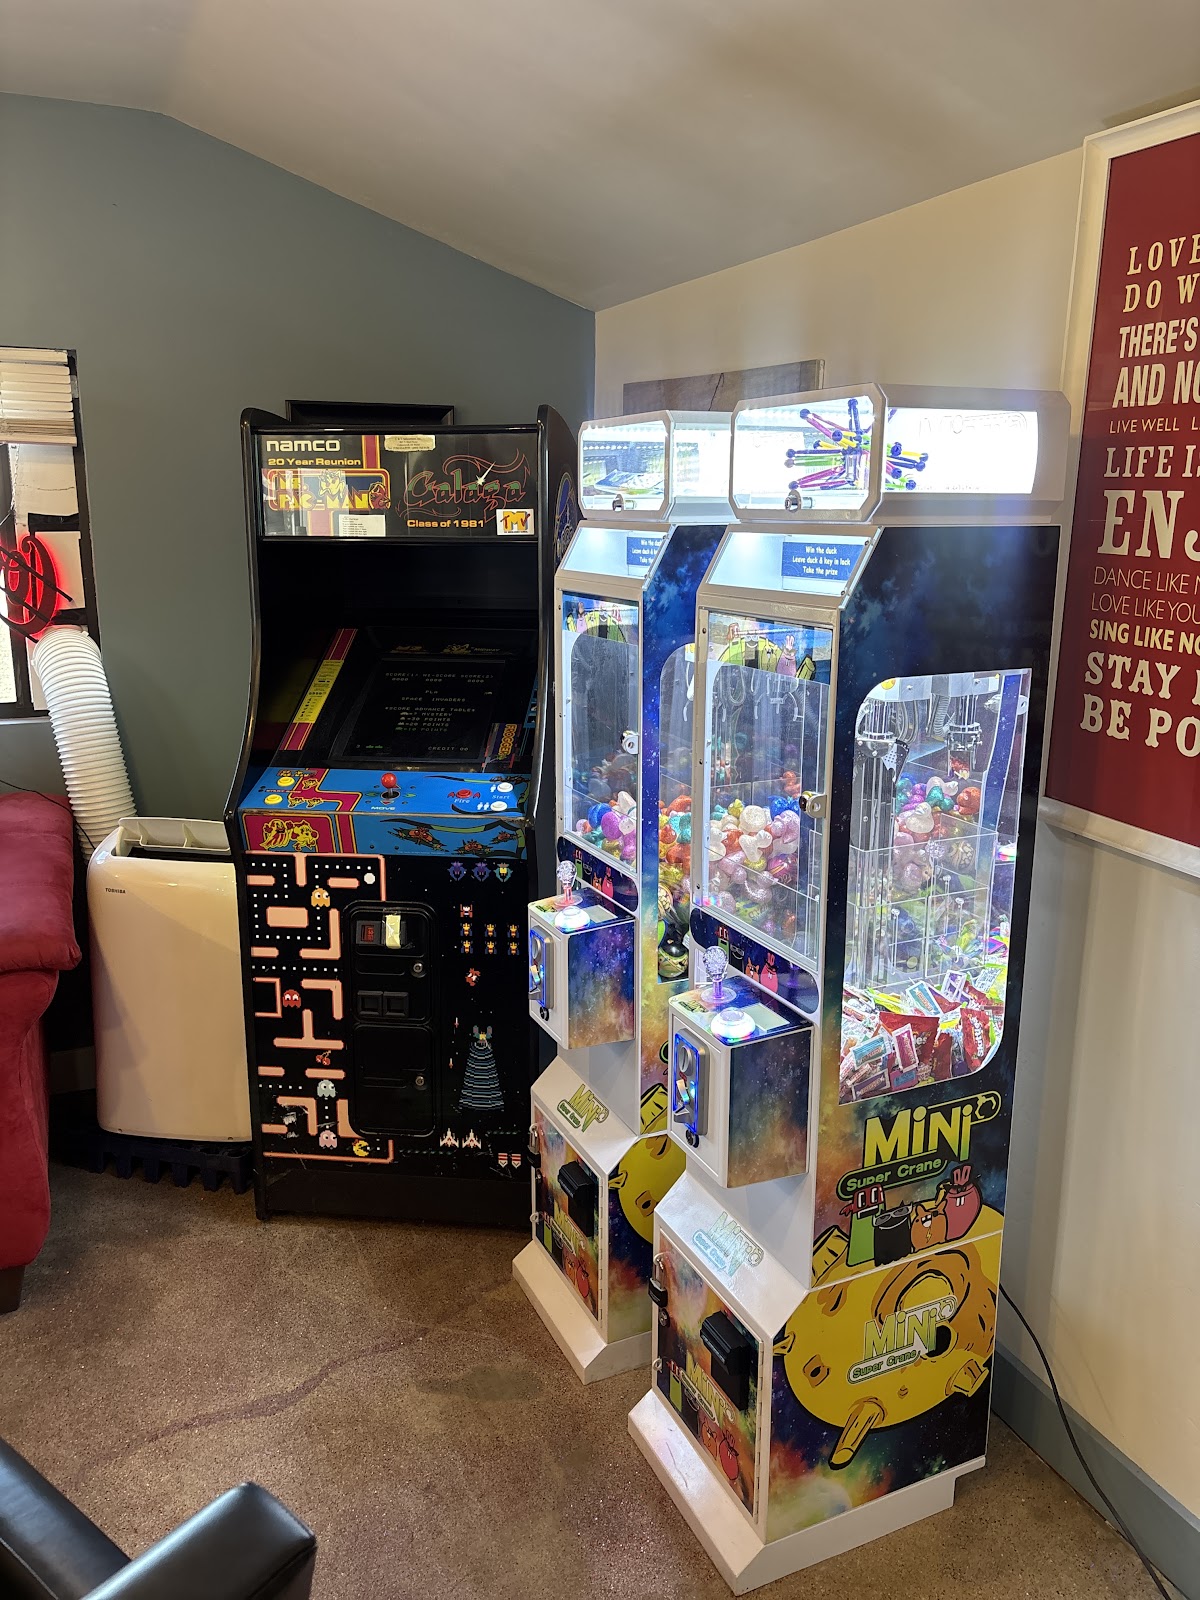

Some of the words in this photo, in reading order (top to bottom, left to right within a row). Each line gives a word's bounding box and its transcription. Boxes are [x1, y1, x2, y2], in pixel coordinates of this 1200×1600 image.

[1122, 280, 1162, 313] DO
[1176, 273, 1200, 304] W
[1119, 316, 1199, 359] THERE'S
[1111, 363, 1166, 409] AND
[1109, 419, 1138, 434] LIVE
[1141, 417, 1180, 433] WELL
[266, 440, 341, 452] namco
[268, 458, 285, 466] 20
[286, 458, 314, 466] Year
[315, 458, 361, 466] Reunion
[1103, 446, 1175, 478] LIFE
[407, 520, 439, 528] Class
[440, 520, 451, 528] of
[453, 520, 485, 528] 1981
[792, 556, 806, 564] Leave
[806, 556, 818, 565] duck
[824, 557, 833, 567] key
[834, 558, 839, 566] in
[840, 558, 851, 566] lock
[805, 546, 815, 554] Win
[816, 546, 825, 555] the
[825, 547, 838, 555] duck
[803, 566, 815, 574] Take
[816, 567, 825, 575] the
[825, 568, 838, 577] prize
[1094, 566, 1152, 590] DANCE
[1156, 572, 1191, 595] LIKE
[1091, 592, 1130, 615] LOVE
[1134, 597, 1165, 619] LIKE
[1089, 618, 1130, 644] SING
[1133, 625, 1175, 651] LIKE
[1085, 651, 1181, 700] STAY
[1080, 693, 1131, 741] BE
[846, 1172, 891, 1192] Super
[897, 1158, 942, 1178] Crane
[852, 1361, 883, 1378] Super
[886, 1349, 917, 1368] Crane
